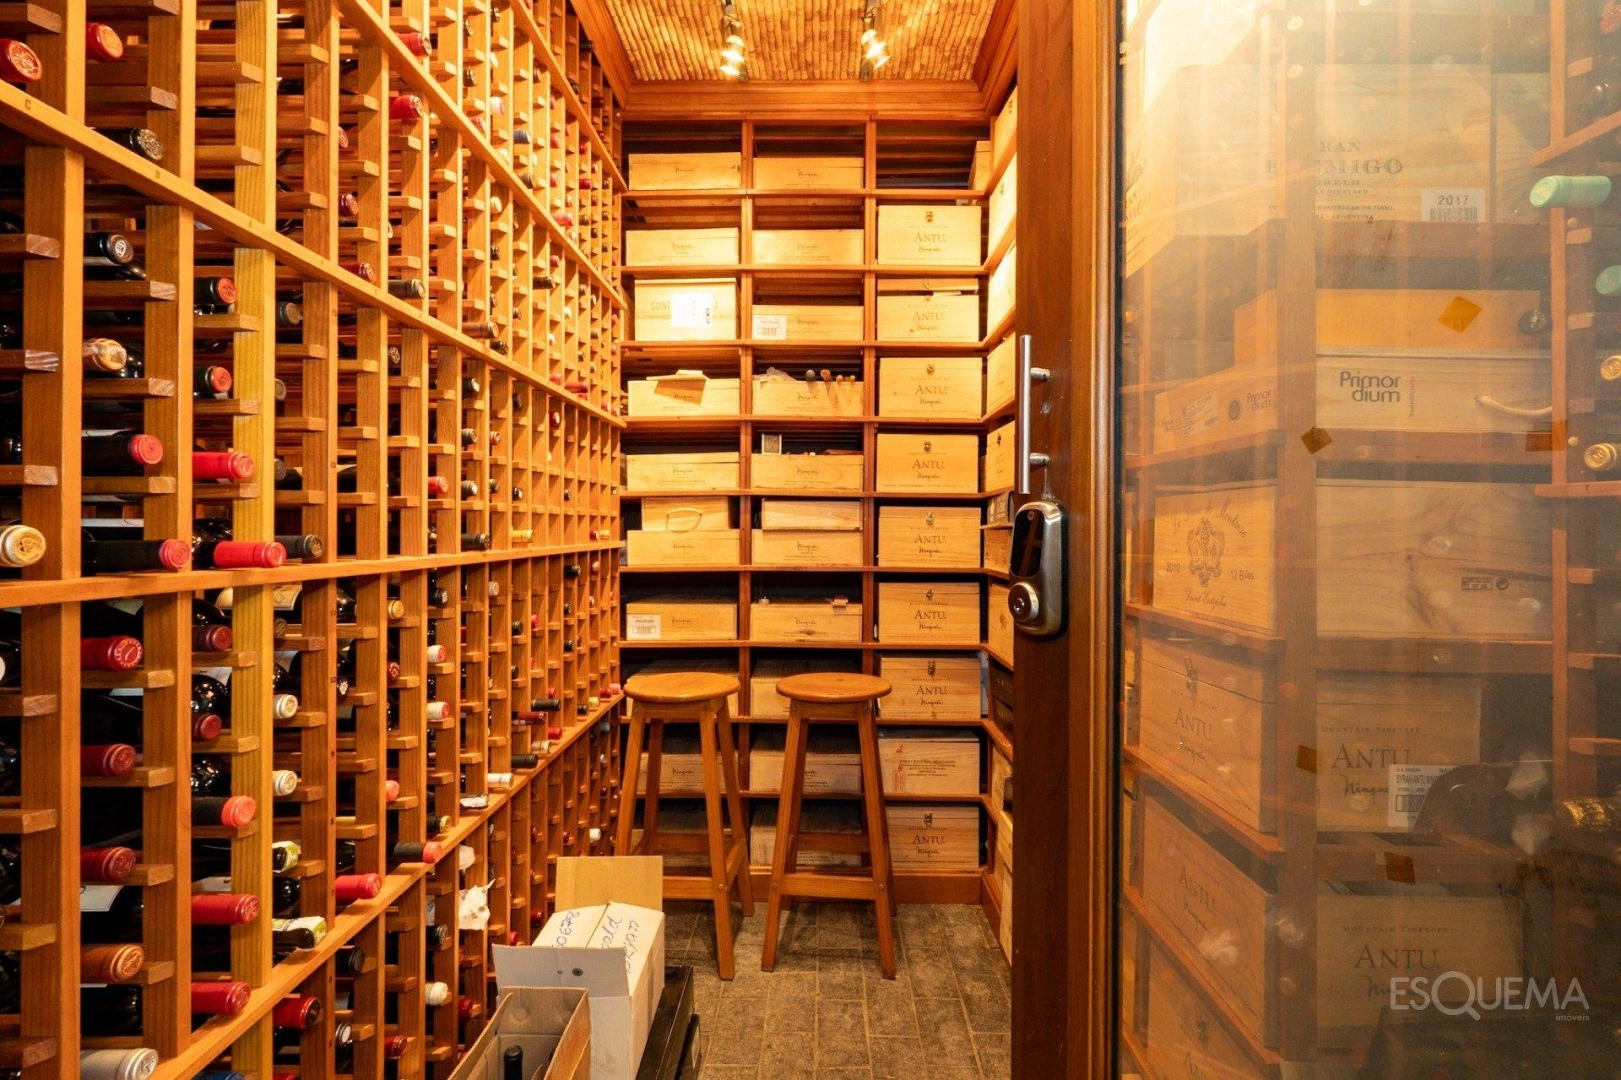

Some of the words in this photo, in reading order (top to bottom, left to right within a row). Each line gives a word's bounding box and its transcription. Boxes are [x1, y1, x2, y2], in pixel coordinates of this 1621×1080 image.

[1437, 195, 1470, 206] 2017
[1340, 370, 1401, 389] Primor
[1352, 386, 1400, 402] dium
